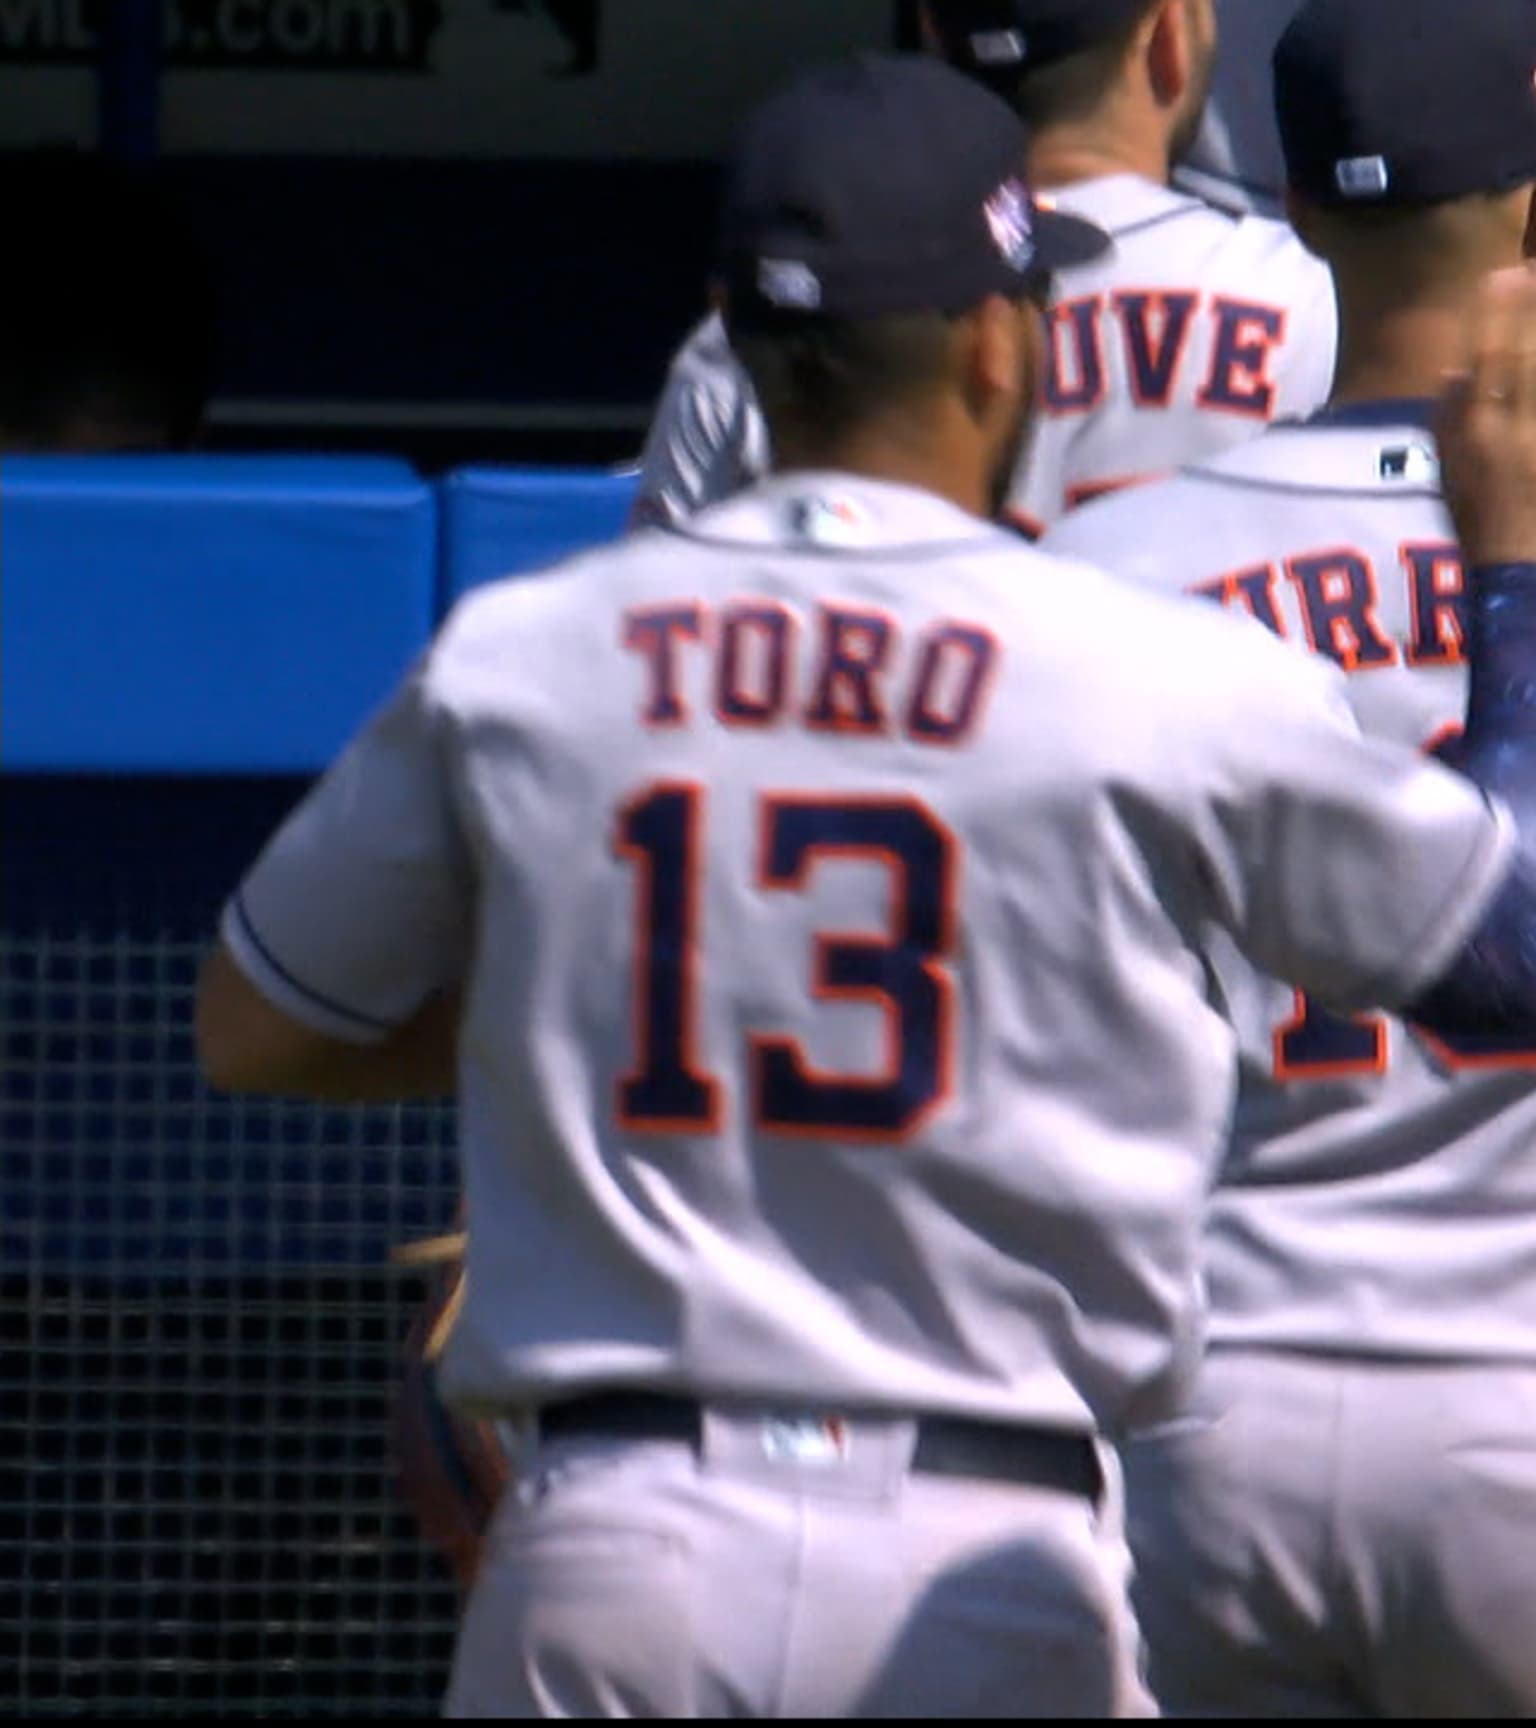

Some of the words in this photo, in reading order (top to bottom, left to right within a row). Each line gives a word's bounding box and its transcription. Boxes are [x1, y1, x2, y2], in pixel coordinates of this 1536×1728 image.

[0, 0, 413, 52] ML.com
[621, 597, 1002, 748] TORO
[613, 781, 959, 1143] 13
